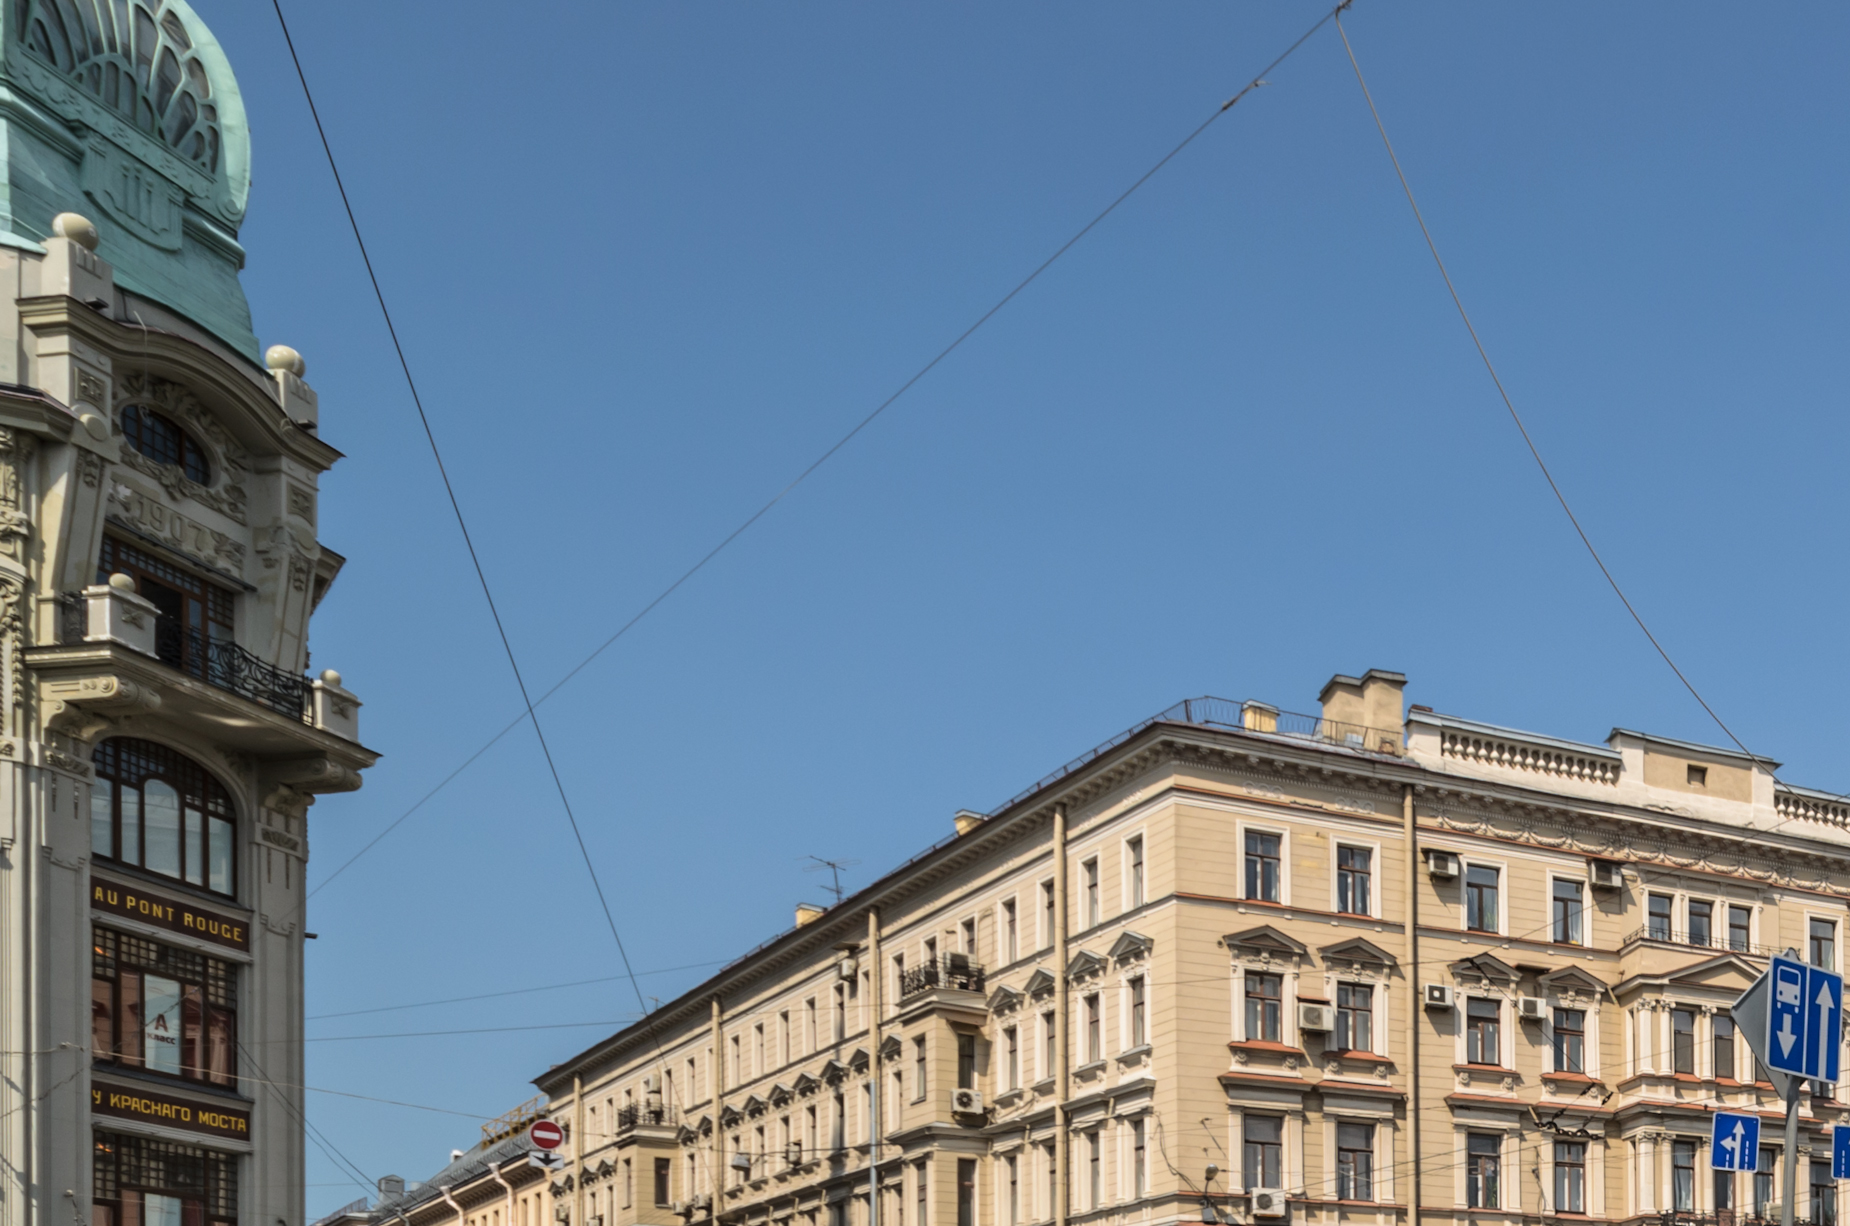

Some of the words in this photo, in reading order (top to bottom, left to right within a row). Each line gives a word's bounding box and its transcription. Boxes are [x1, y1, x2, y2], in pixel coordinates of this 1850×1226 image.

[136, 498, 206, 553] 1907
[95, 886, 118, 905] AU
[126, 895, 174, 921] PONT
[184, 912, 243, 942] ROUGE
[147, 1033, 176, 1045] класс
[92, 1089, 102, 1104] У
[110, 1093, 191, 1121] КРАСНАГО
[199, 1110, 247, 1132] МОСТА
